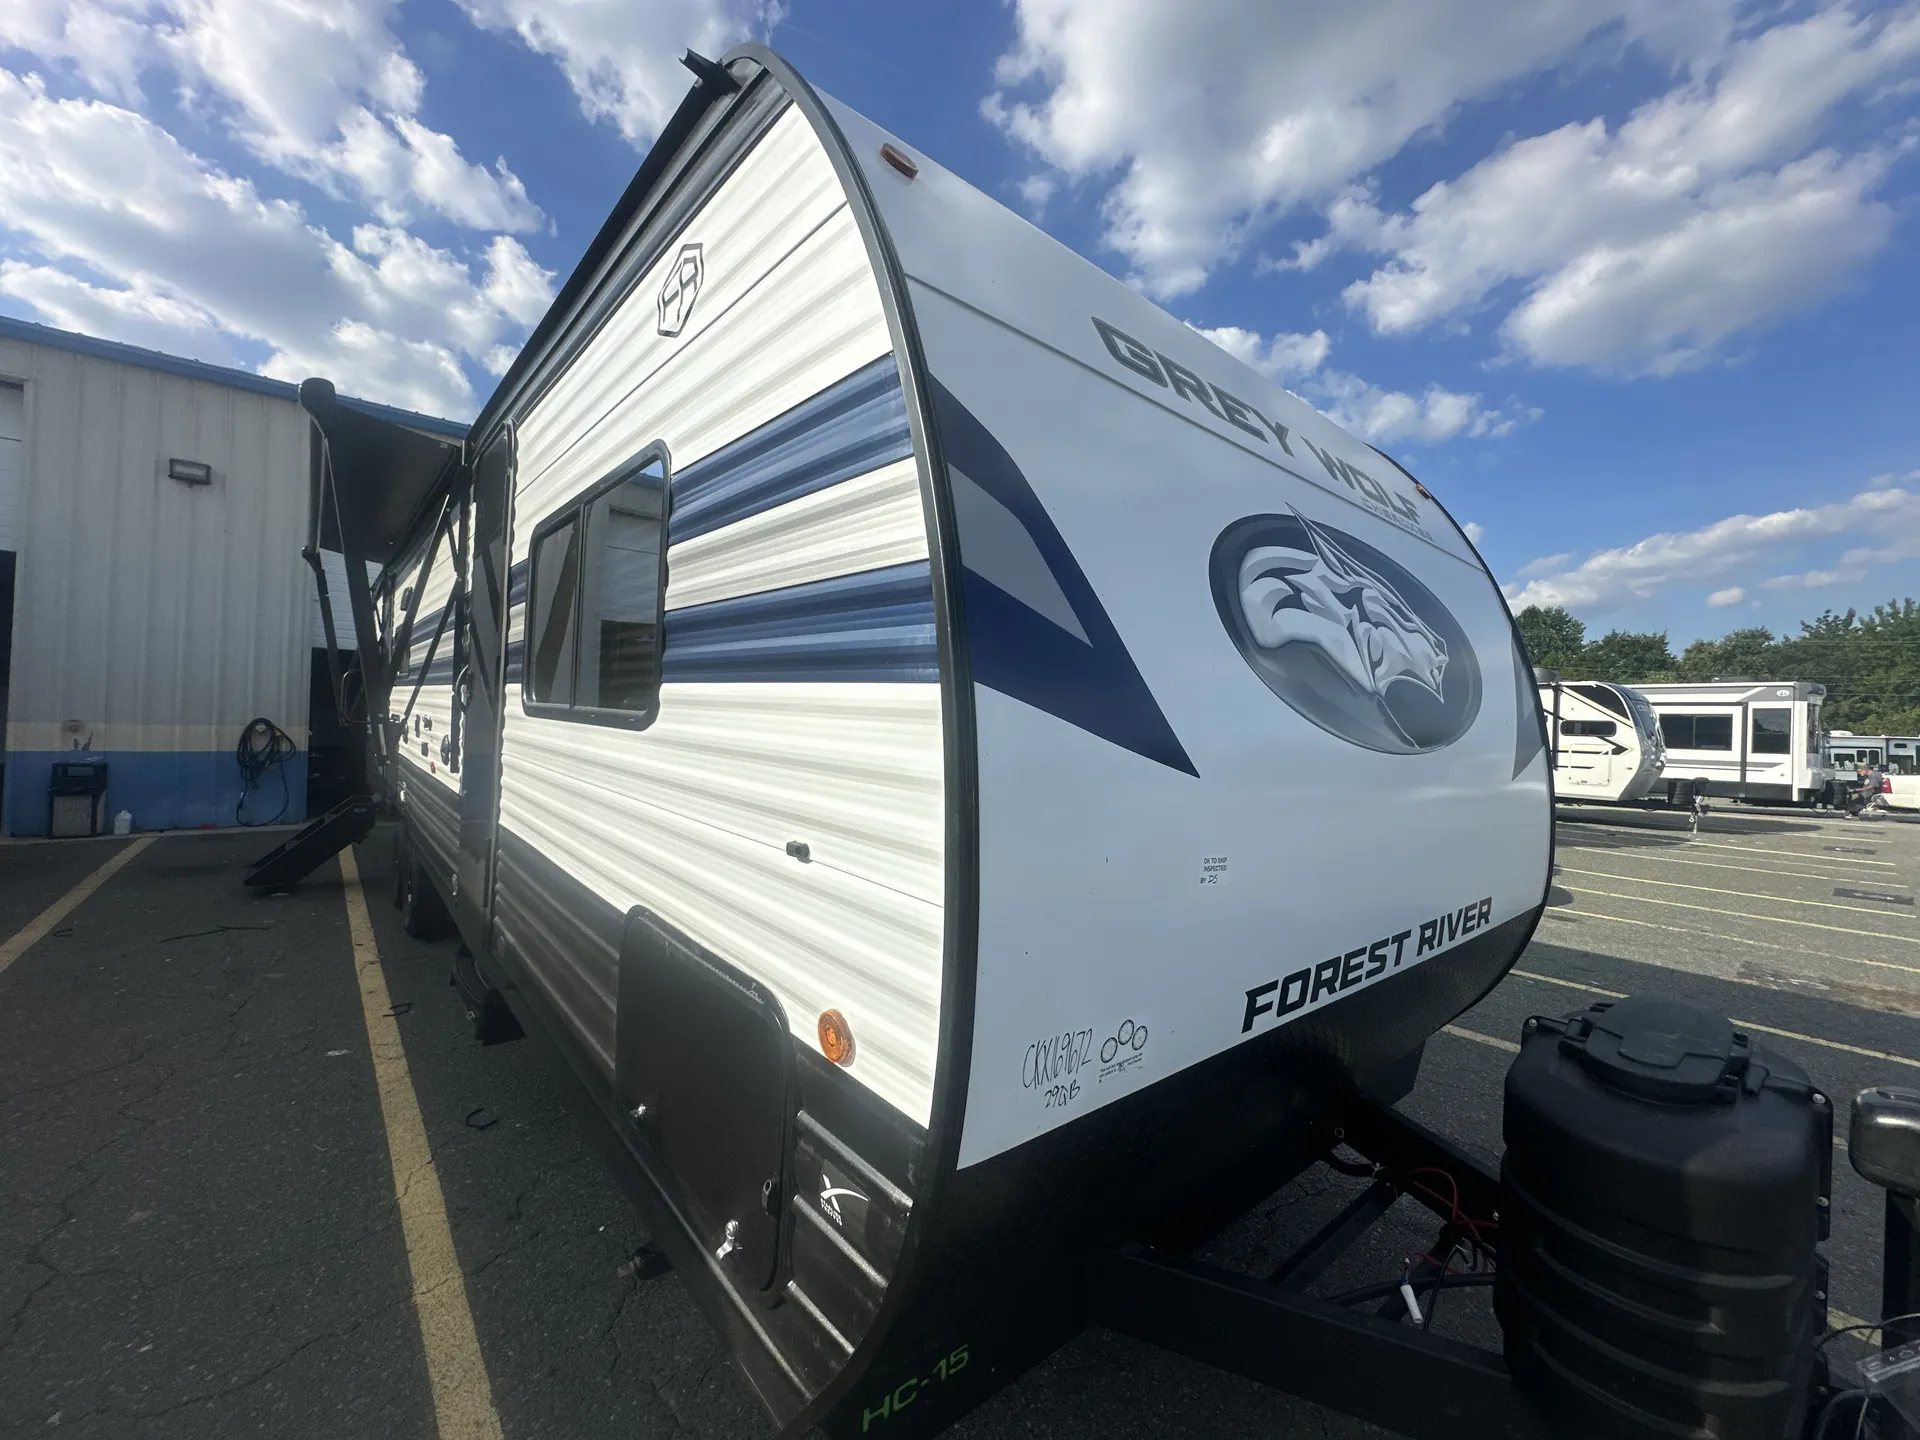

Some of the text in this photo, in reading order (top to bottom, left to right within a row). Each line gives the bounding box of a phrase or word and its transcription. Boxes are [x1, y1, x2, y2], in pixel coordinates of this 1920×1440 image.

[1091, 316, 1421, 526] GREY WOLF
[1203, 864, 1227, 872] INSPECTED
[1241, 896, 1493, 1034] FOREST RIVER
